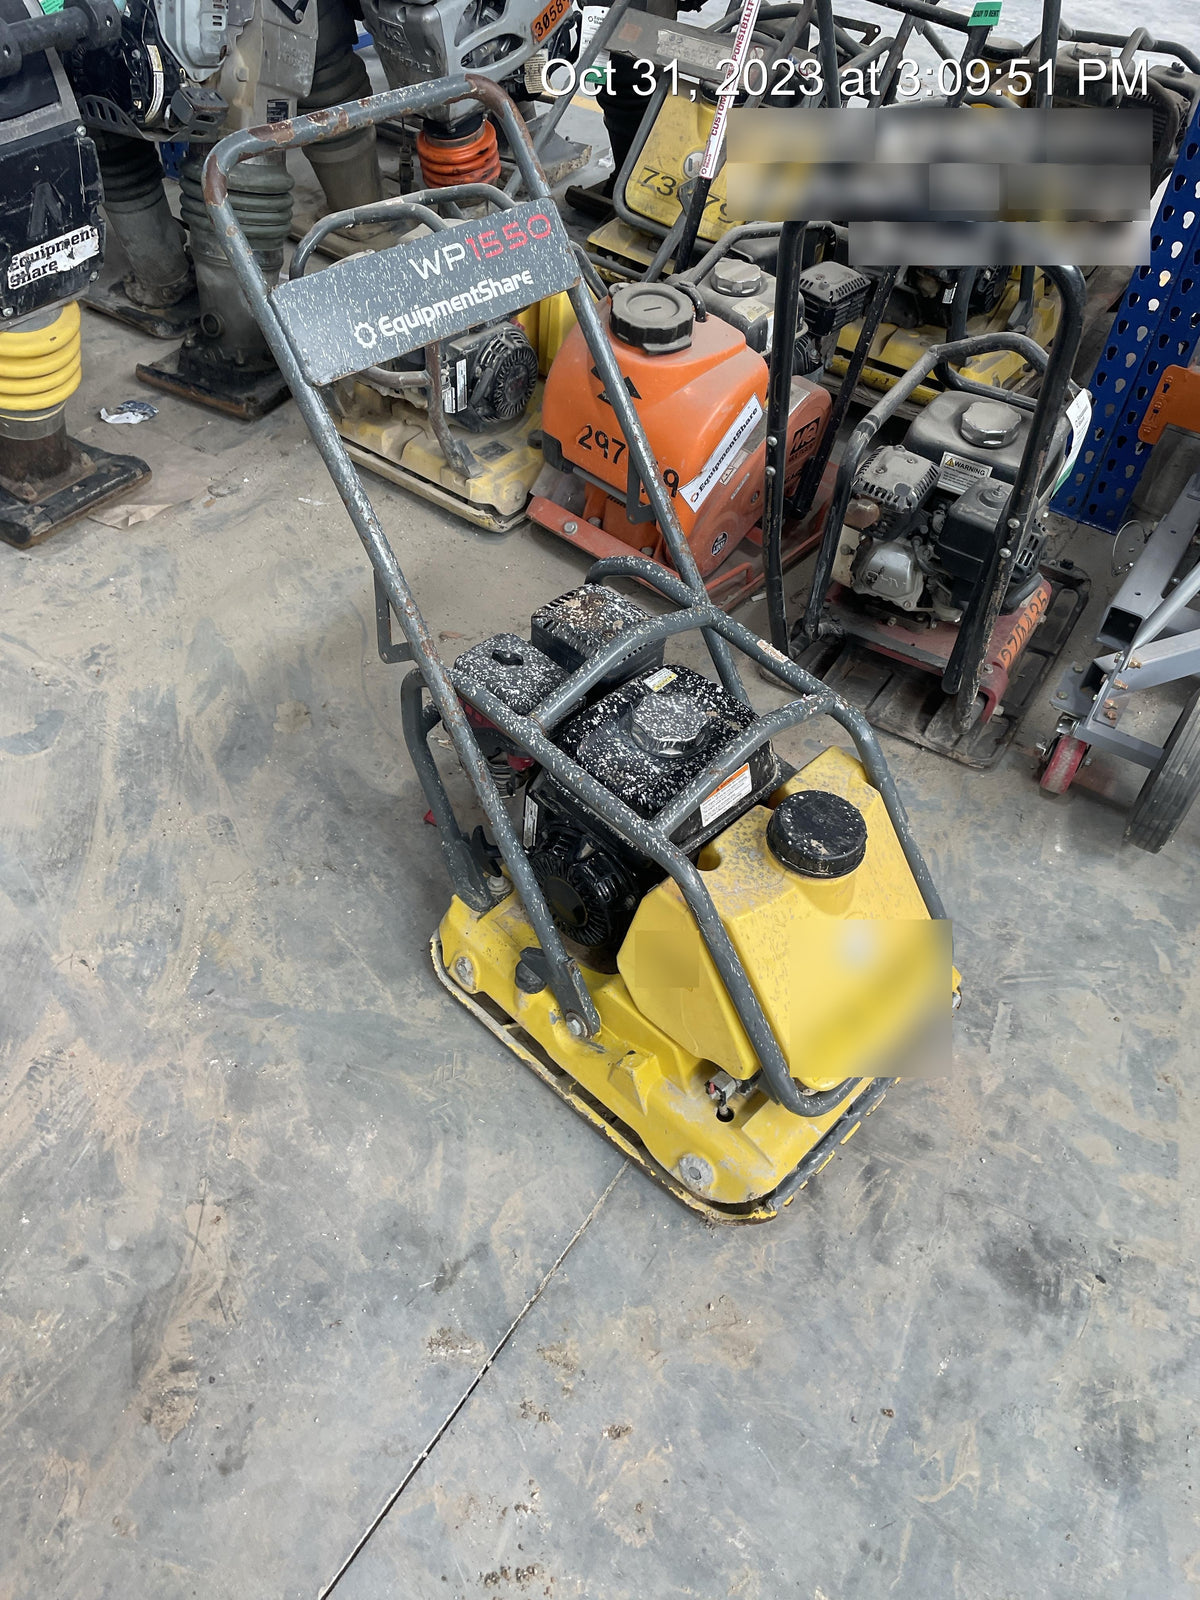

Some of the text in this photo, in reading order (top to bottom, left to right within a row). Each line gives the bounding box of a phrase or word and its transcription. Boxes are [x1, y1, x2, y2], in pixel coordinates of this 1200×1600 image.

[10, 228, 98, 273] Equipment
[10, 260, 58, 288] Share
[408, 214, 552, 280] WP1550
[378, 269, 534, 337] EquipmentShare
[698, 407, 758, 492] EquipmentShare
[954, 461, 986, 476] WARNING
